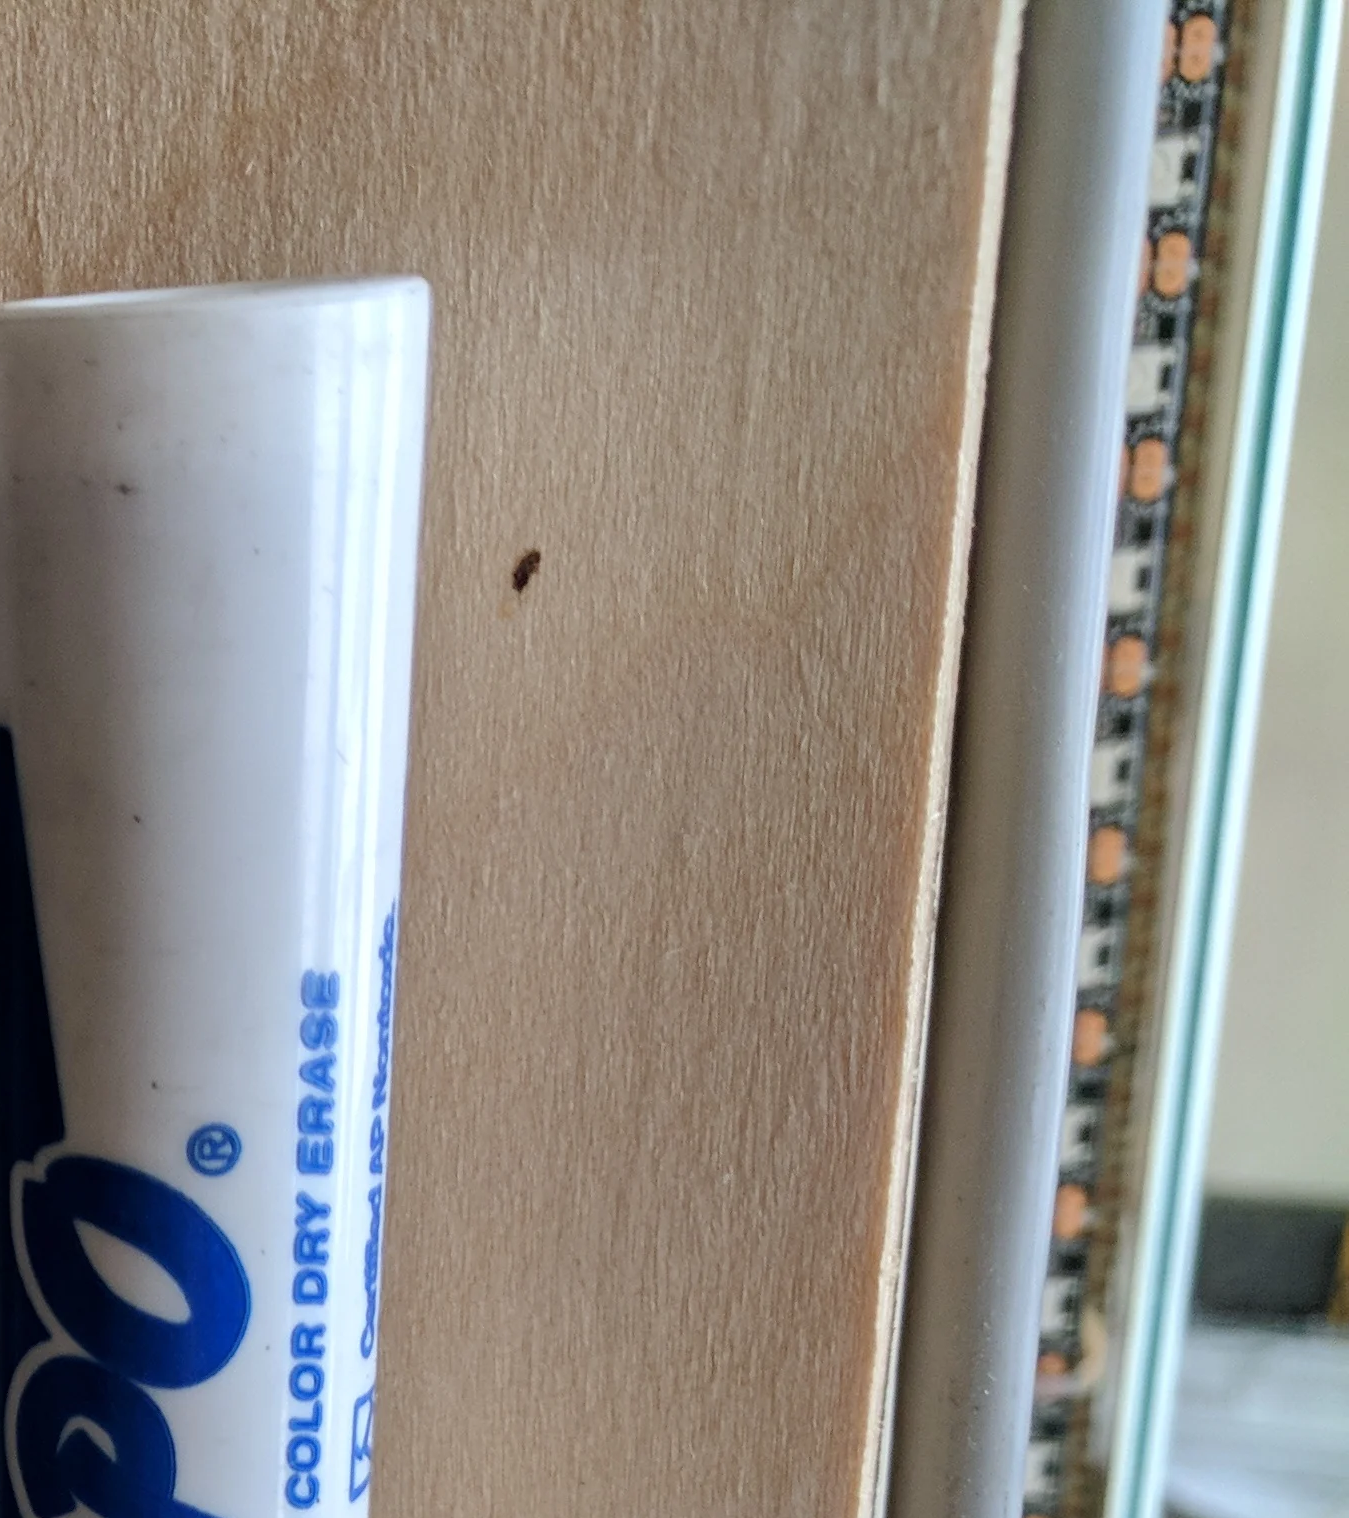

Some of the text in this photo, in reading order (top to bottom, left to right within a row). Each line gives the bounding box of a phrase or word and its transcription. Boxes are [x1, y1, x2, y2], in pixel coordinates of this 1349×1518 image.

[296, 968, 341, 1176] ERASE
[292, 1191, 332, 1306] DRY
[285, 1321, 327, 1510] COLOR
